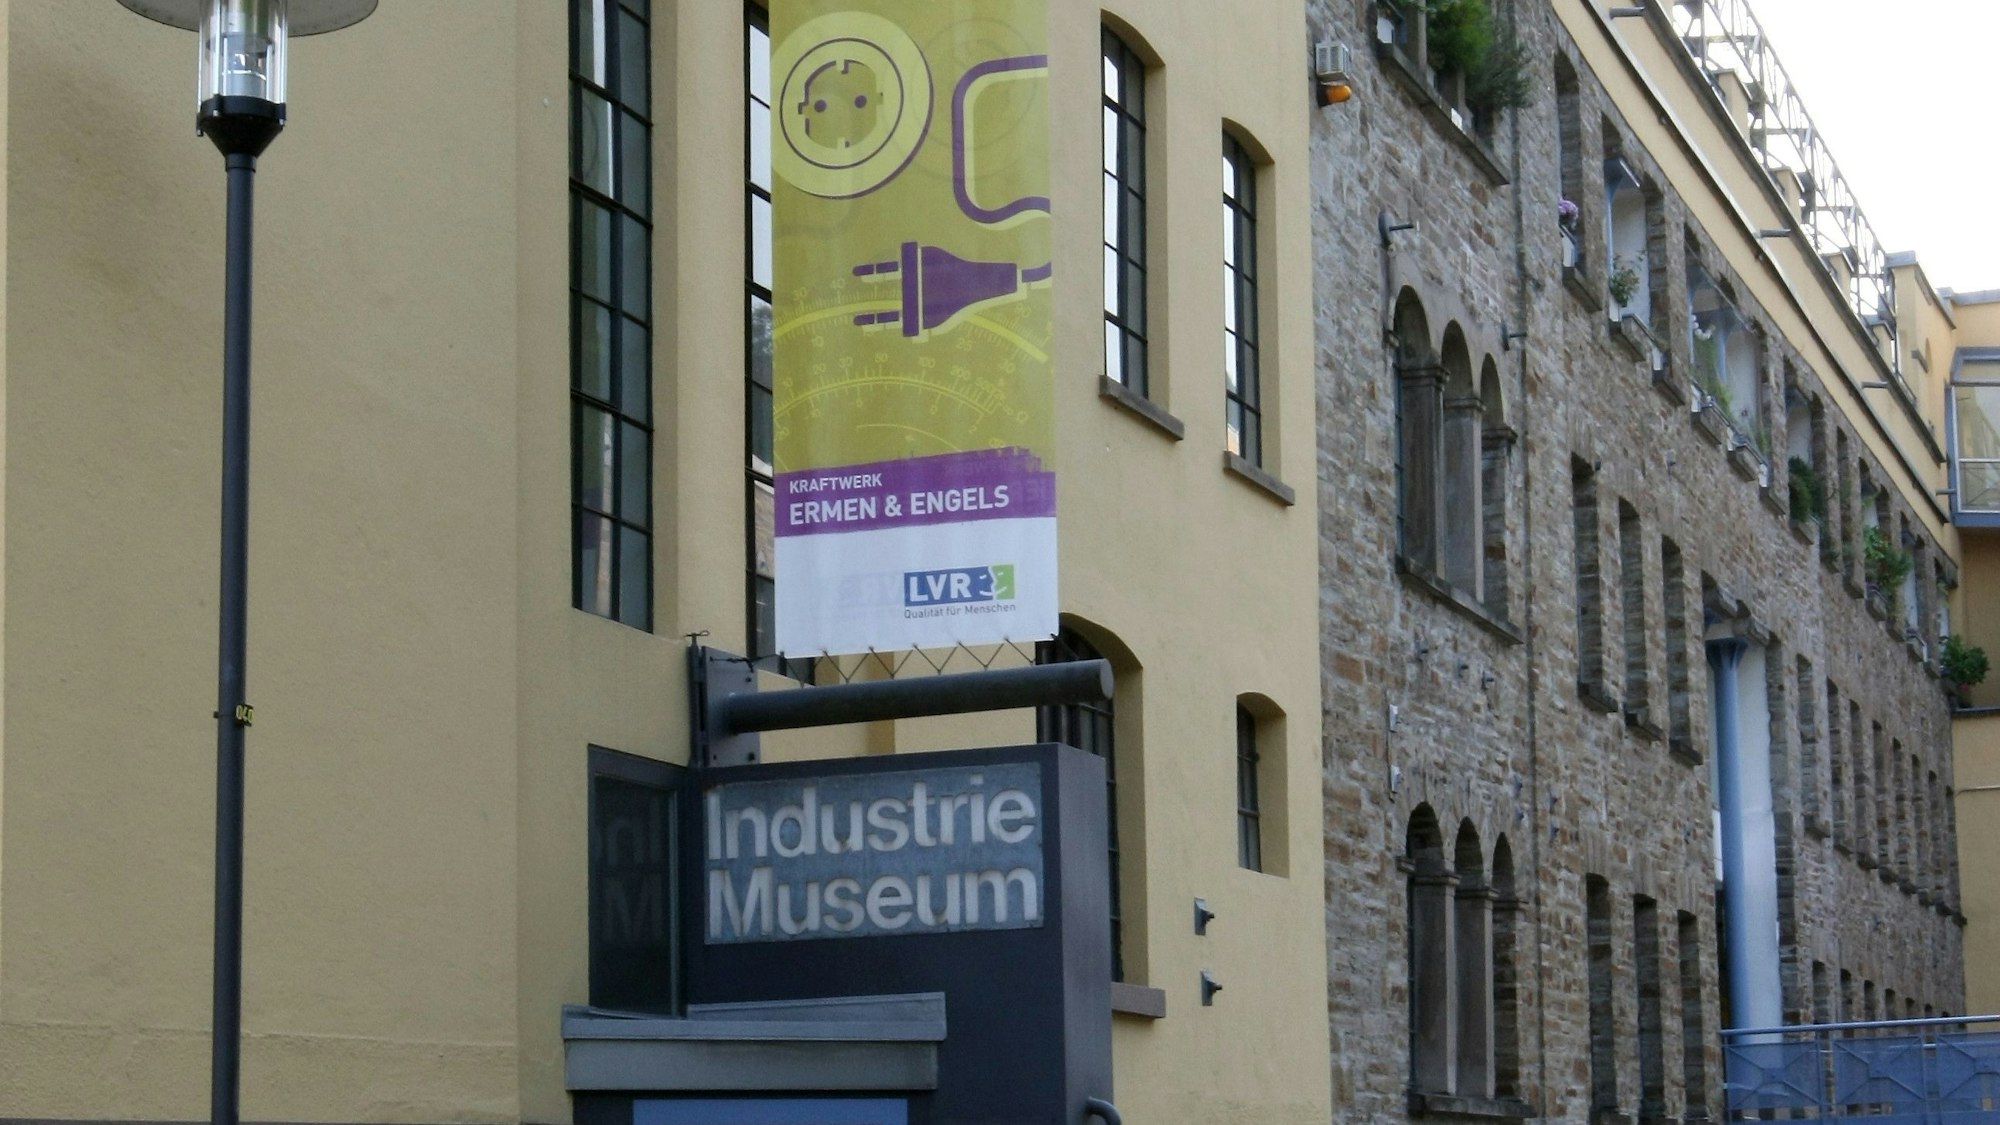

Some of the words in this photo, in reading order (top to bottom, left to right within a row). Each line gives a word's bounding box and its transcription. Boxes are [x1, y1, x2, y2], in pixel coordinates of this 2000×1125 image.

[789, 473, 882, 494] KRAFTWERK
[789, 497, 877, 525] ERMEN
[884, 495, 902, 517] &
[910, 485, 1010, 515] ENGELS
[910, 573, 972, 601] LVR
[904, 606, 944, 619] Qualität
[946, 606, 960, 616] für
[964, 604, 1016, 615] Menschen
[706, 774, 1036, 860] Industrie
[708, 866, 1037, 938] Museum
